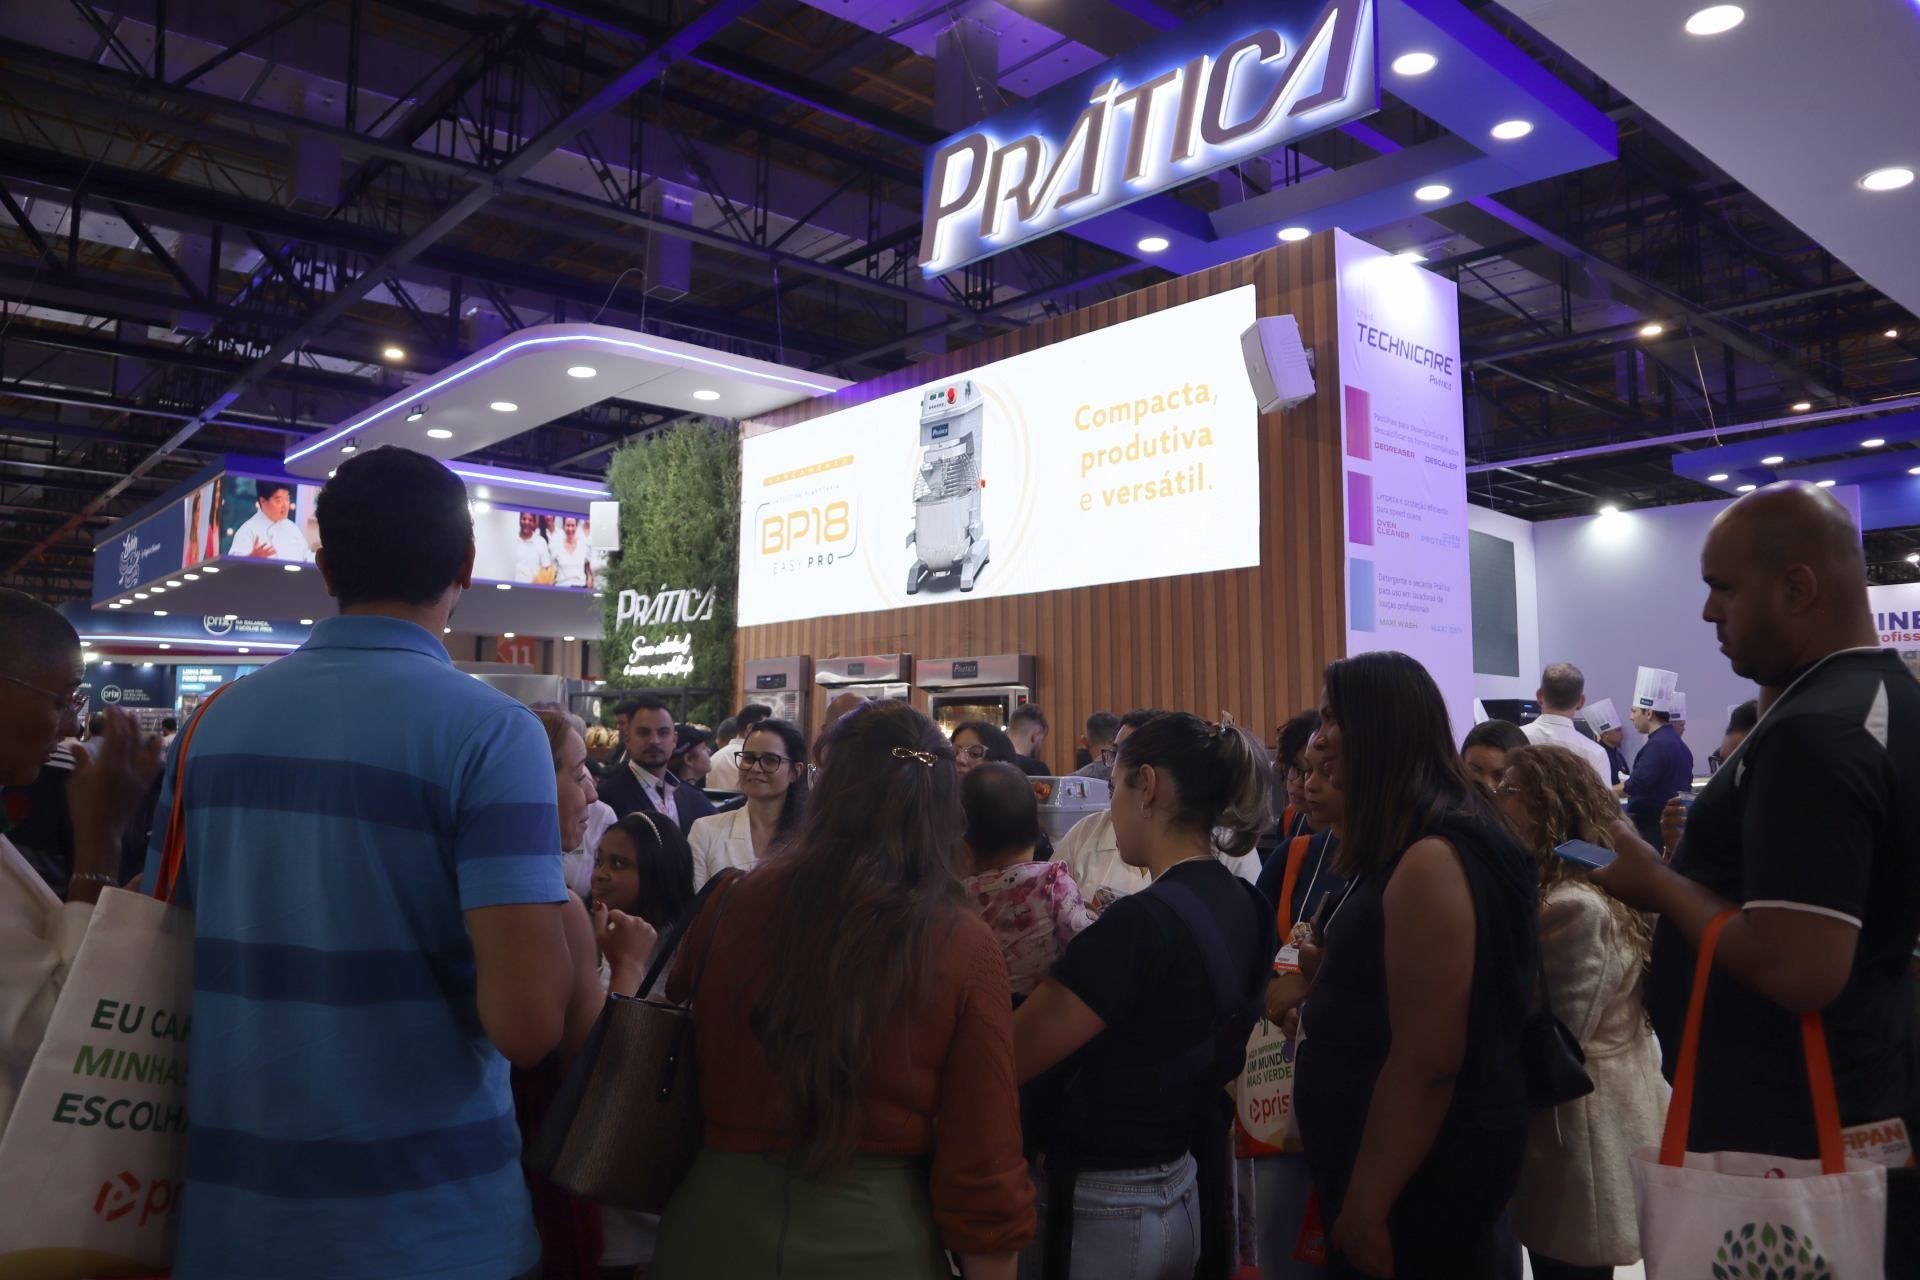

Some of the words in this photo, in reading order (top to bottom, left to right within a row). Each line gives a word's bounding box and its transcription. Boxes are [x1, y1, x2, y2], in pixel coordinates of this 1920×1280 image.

[917, 0, 1366, 269] PRÁTICA
[1357, 322, 1454, 376] TECHNICARE
[1074, 382, 1218, 431] Compacta,
[1080, 425, 1214, 478] produtiva
[1374, 441, 1416, 458] DEGREASER
[1424, 455, 1458, 470] DESCALER
[1079, 491, 1093, 511] e
[1102, 462, 1213, 507] versátil.
[761, 500, 849, 555] BP18
[1376, 519, 1397, 529] OVEN
[1376, 526, 1410, 540] CLEANER
[772, 559, 801, 575] EASY
[808, 552, 834, 568] PRO
[615, 583, 717, 633] PRÁTICA
[1877, 632, 1920, 643] ofiss
[90, 999, 145, 1034] EU
[1258, 1040, 1286, 1056] IMPRIMIMO
[1247, 1073, 1262, 1088] MAIS
[1263, 1066, 1293, 1083] VERDE
